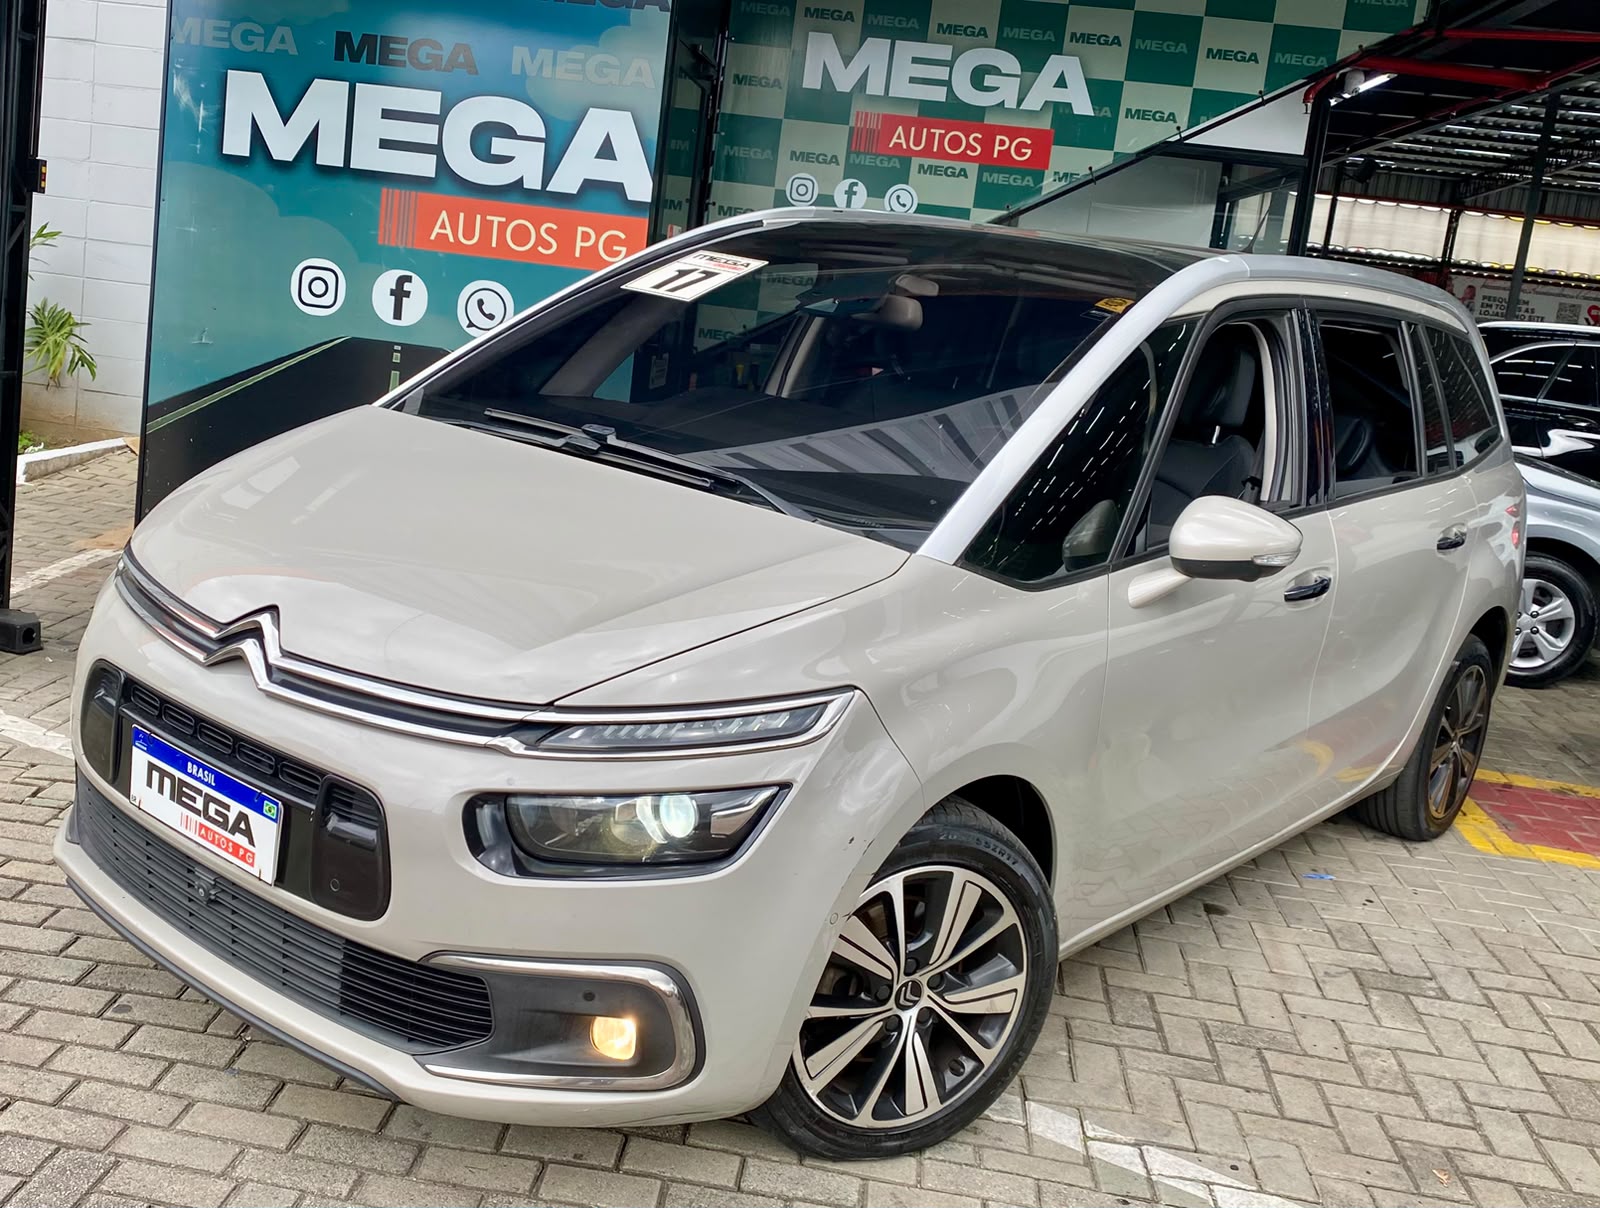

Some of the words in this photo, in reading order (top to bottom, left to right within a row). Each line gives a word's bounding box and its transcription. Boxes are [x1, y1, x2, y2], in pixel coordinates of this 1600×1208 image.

[740, 1, 791, 17] MEGA
[804, 7, 855, 23] MEGA
[867, 14, 919, 30] MEGA
[172, 16, 298, 56] MEGA
[936, 23, 989, 39] MEGA
[1003, 26, 1055, 42] MEGA
[1069, 32, 1122, 48] MEGA
[1135, 38, 1188, 54] MEGA
[334, 30, 479, 76] MEGA
[1206, 48, 1259, 65] MEGA
[1275, 54, 1328, 68] MEGA
[511, 46, 655, 89] MEGA
[802, 31, 1094, 116] MEGA
[732, 73, 782, 89] MEGA
[1125, 107, 1177, 124] MEGA
[222, 69, 653, 202] MEGA
[888, 125, 982, 157] AUTOS
[993, 135, 1032, 161] PG
[724, 144, 773, 161] MEGA
[790, 150, 840, 166] MEGA
[850, 153, 900, 168] MEGA
[918, 163, 968, 179] MEGA
[982, 172, 1034, 187] MEGA
[430, 210, 558, 256] AUTOS
[574, 228, 628, 263] PG
[650, 268, 722, 293] 17
[698, 327, 738, 341] MEG
[187, 762, 216, 786] BRASIL
[146, 760, 256, 848] MEGA
[200, 827, 233, 852] AUTOS
[239, 847, 253, 863] PG
